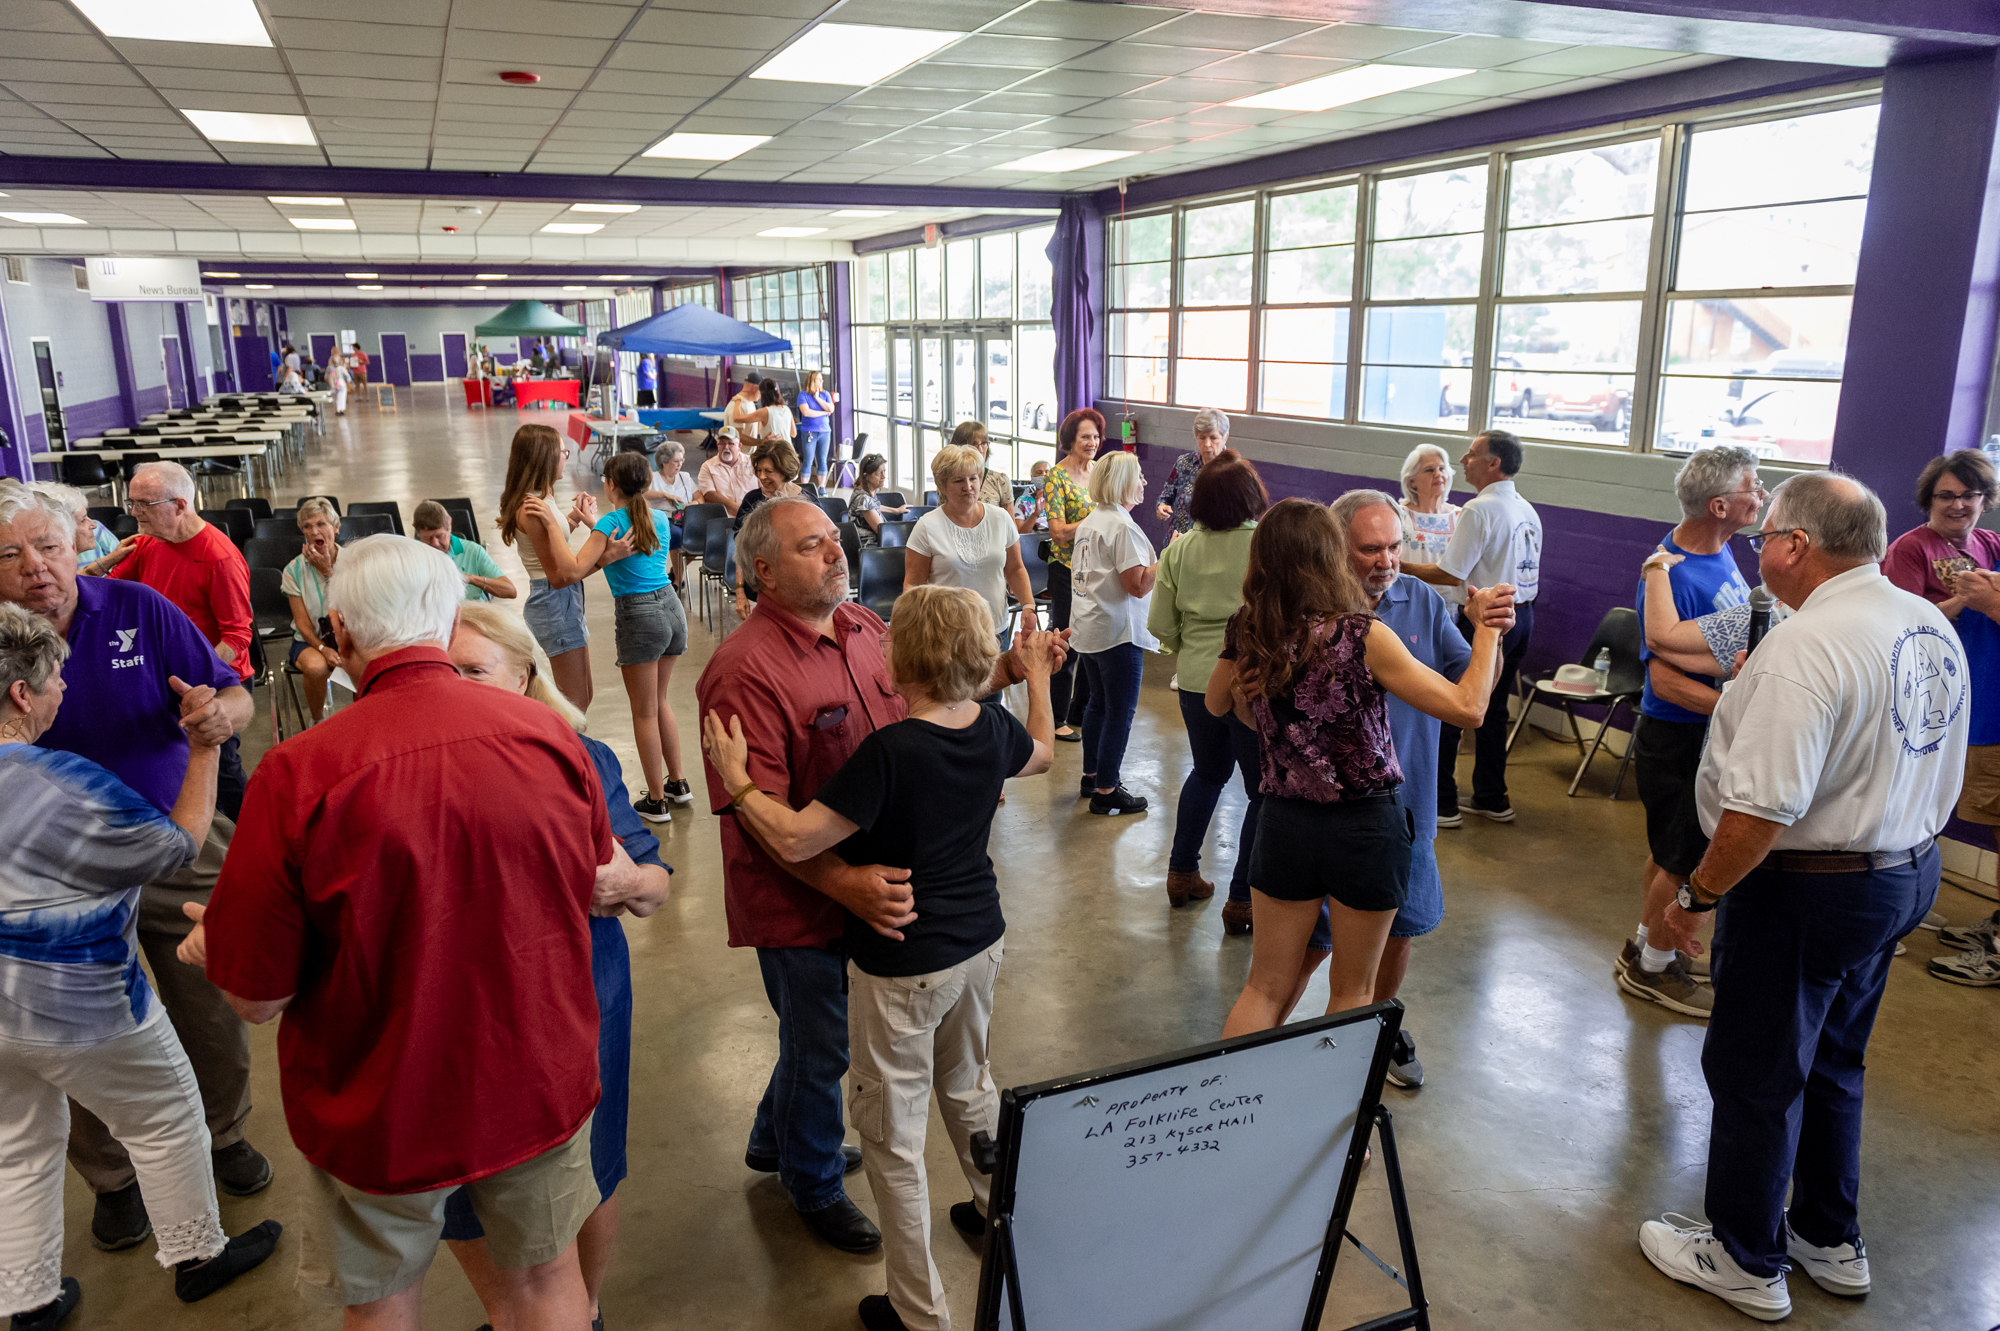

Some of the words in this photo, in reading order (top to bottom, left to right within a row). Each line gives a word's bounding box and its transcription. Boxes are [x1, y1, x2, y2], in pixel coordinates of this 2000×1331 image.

[139, 285, 164, 295] News
[167, 285, 199, 295] Bureau
[1890, 636, 1903, 676] CHAPITRE
[1916, 625, 1939, 636] BATON
[111, 654, 145, 669] Staff
[1889, 707, 1905, 734] AIDEZ
[1084, 1121, 1113, 1139] LA
[1123, 1133, 1157, 1148] 213
[1125, 1139, 1221, 1169] 357-4332
